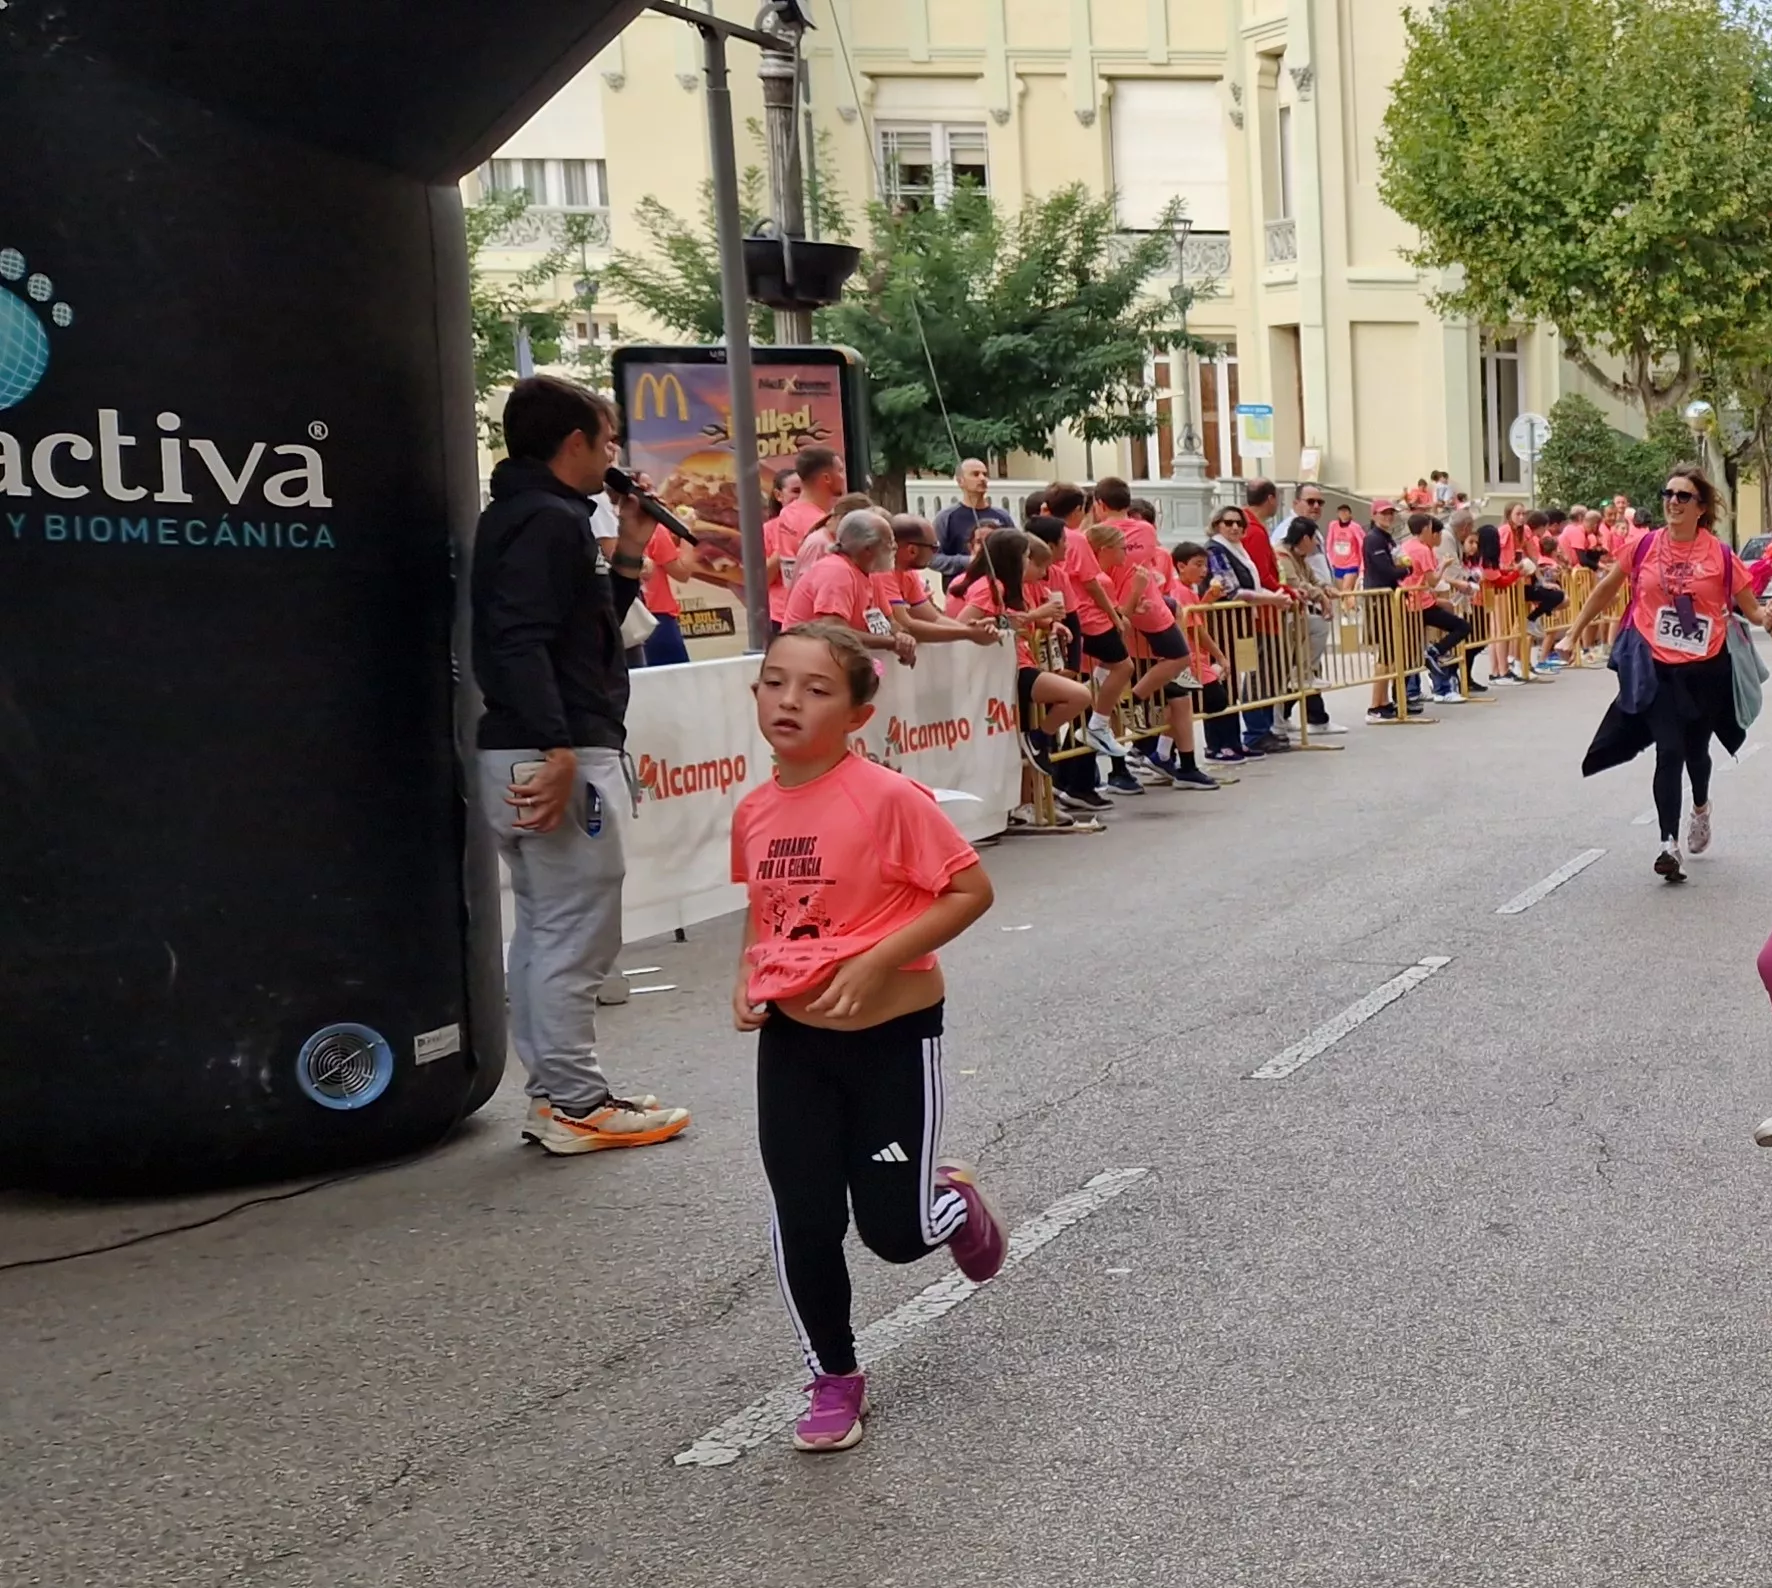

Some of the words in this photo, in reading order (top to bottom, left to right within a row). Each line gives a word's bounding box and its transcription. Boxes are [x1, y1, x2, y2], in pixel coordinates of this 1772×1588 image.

[726, 404, 811, 439] lled
[756, 431, 799, 459] ork
[6, 513, 27, 539] Y
[45, 513, 336, 549] BIOMECÁNICA
[885, 715, 970, 757] Alcampo
[637, 753, 747, 802] Alcampo
